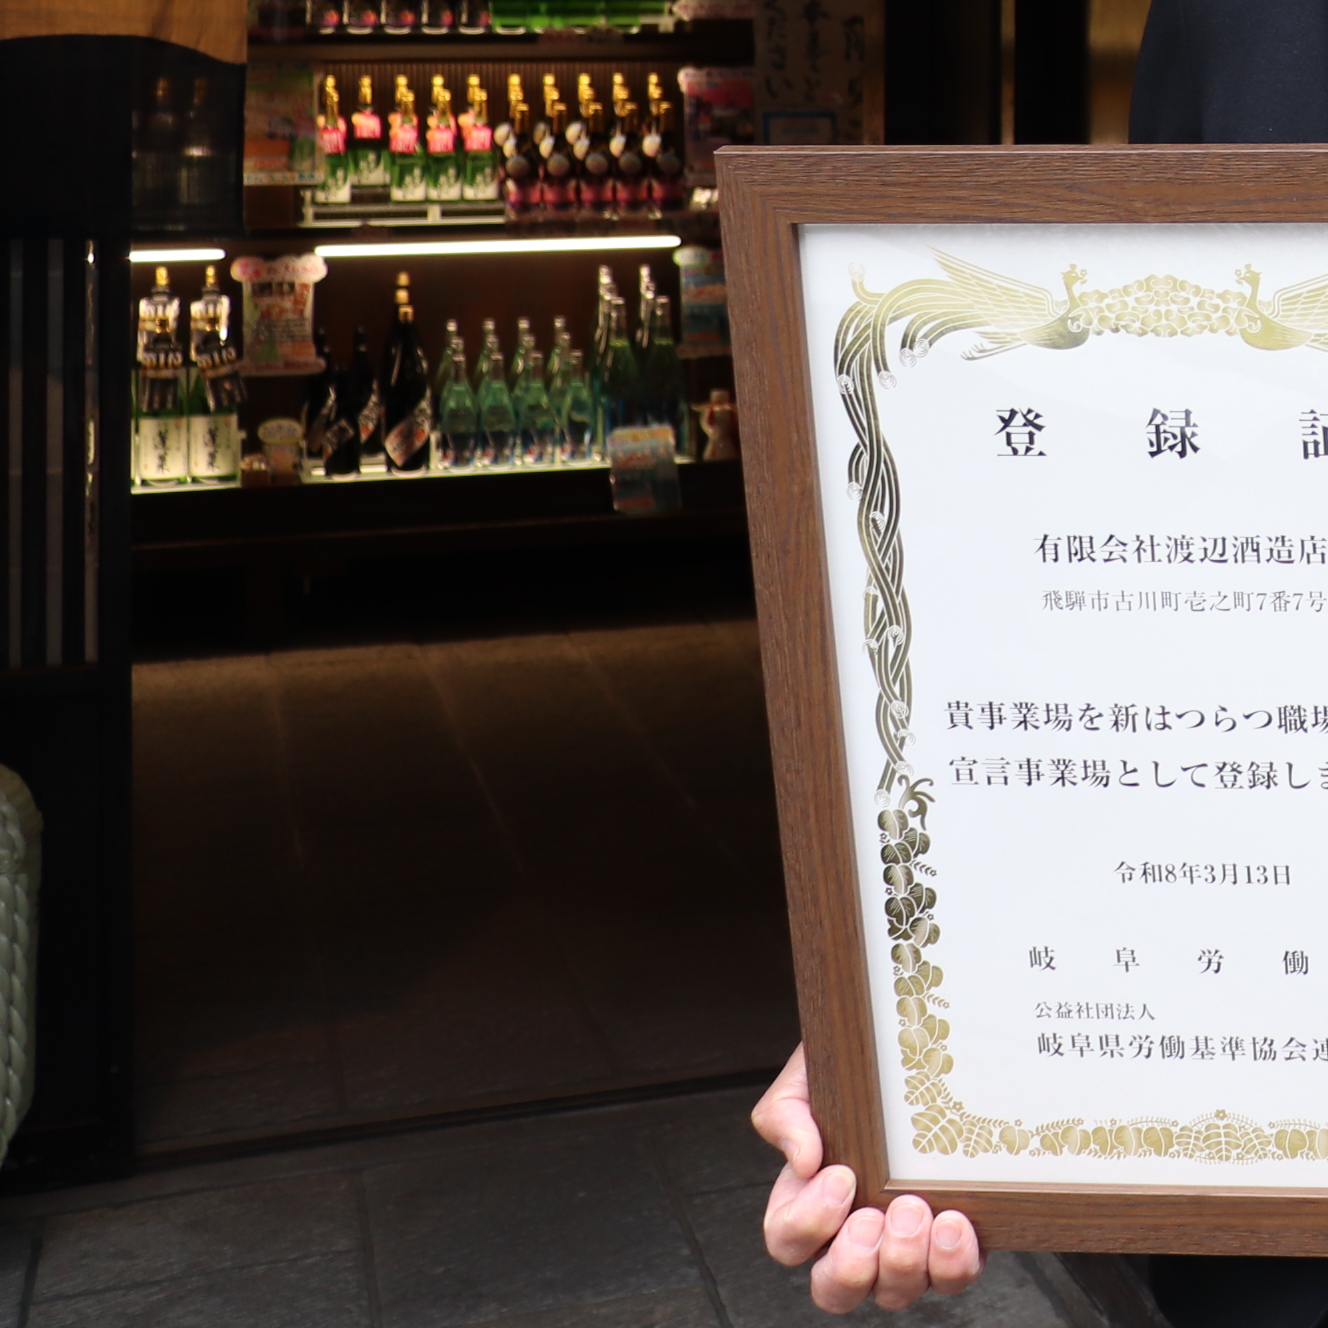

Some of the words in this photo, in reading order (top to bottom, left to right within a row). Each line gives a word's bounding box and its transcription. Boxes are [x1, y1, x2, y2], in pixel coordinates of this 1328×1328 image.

[1033, 533, 1328, 566] 有限会社渡辺酒造店
[1042, 589, 1328, 613] 飛騨市古川町壱之町7番7号
[1113, 860, 1291, 886] 令和8年3月13日
[1034, 1001, 1156, 1021] 公益社団法人
